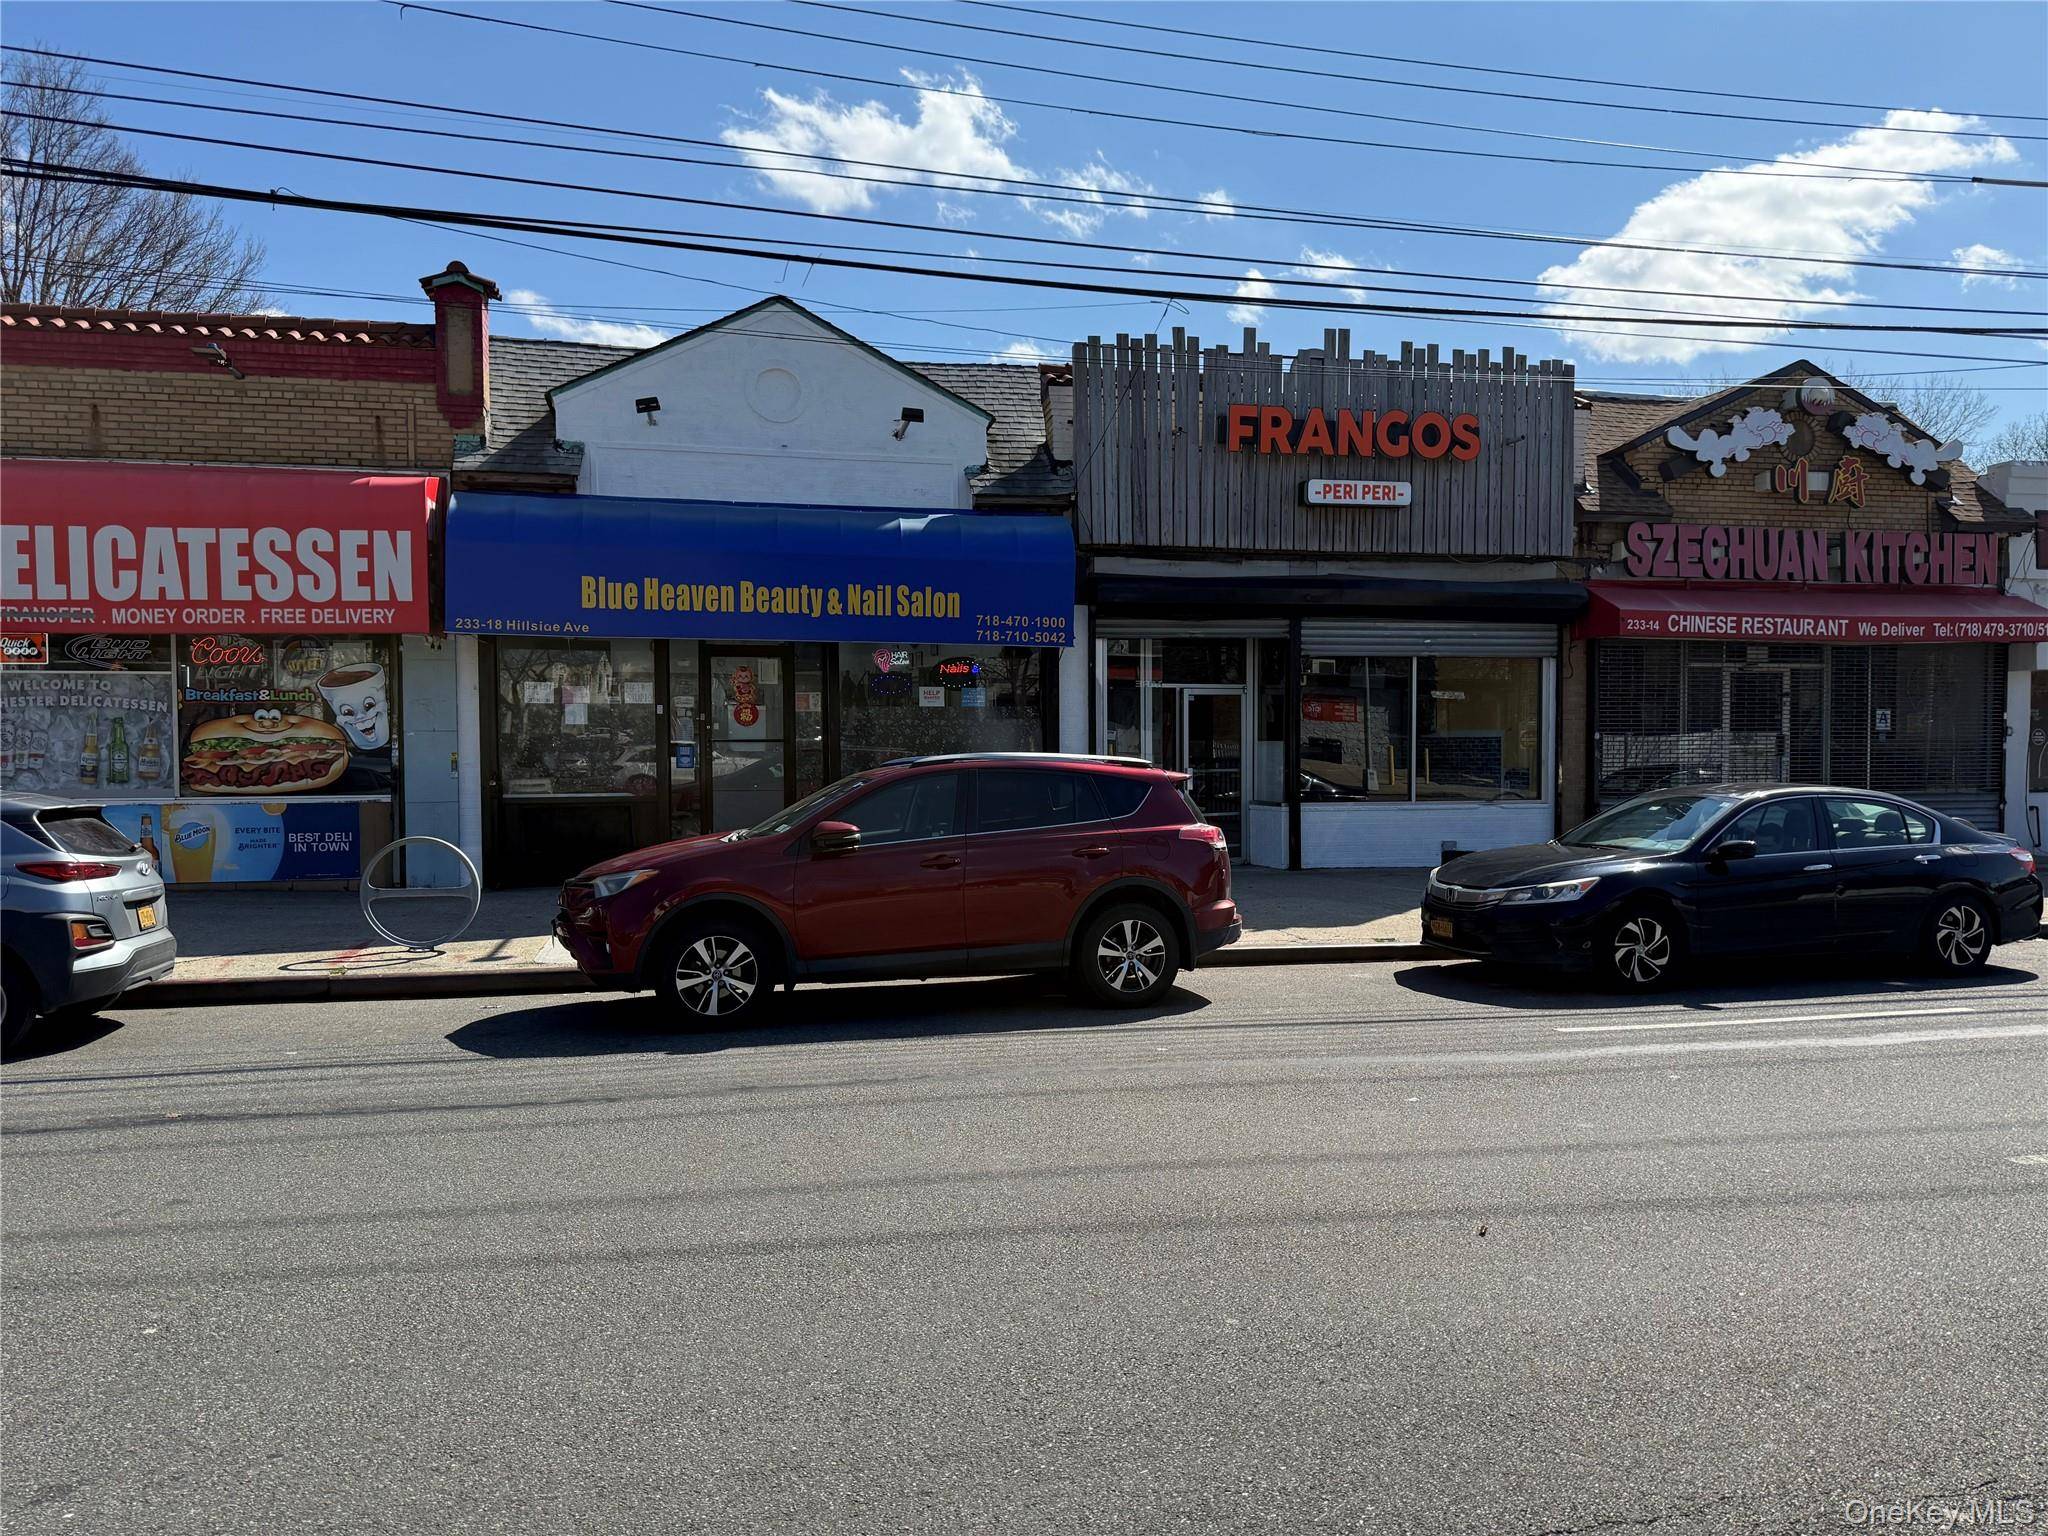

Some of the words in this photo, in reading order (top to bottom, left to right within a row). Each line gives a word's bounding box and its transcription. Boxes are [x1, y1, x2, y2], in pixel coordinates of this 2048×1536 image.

[1228, 404, 1481, 461] FRANGOS
[1626, 521, 1829, 582] SZECHUAN
[1846, 528, 1999, 585] KITCHEN
[0, 525, 413, 602] ELICATESSEN
[581, 575, 638, 610] Blue
[643, 577, 735, 612] Heaven
[740, 580, 823, 618] Beauty
[827, 587, 843, 615] &
[847, 584, 892, 616] Nail
[896, 584, 960, 618] Salon
[112, 608, 177, 624] MONEY
[182, 608, 246, 625] ORDER
[261, 608, 306, 624] FREE
[311, 608, 396, 625] DELIVERY
[976, 614, 1066, 628] 718-470-1900
[455, 617, 503, 630] 233-18
[506, 619, 560, 632] Hillside
[563, 622, 590, 633] Ave
[1627, 619, 1660, 631] 233-14
[1667, 614, 1737, 634] CHINESE
[1741, 616, 1849, 636] RESTAURANT
[1858, 622, 1878, 636] We
[1881, 622, 1926, 637] Deliver
[0, 637, 31, 649] Quick
[91, 637, 150, 649] BUD
[976, 630, 1066, 643] 718-710-5042
[76, 647, 152, 660] LIGHT
[192, 636, 265, 663] Coors
[891, 650, 909, 658] HAIR
[940, 663, 970, 674] Nails
[8, 679, 85, 691] WELCOME
[89, 680, 112, 691] TO
[60, 695, 168, 713] DELICATESSEN
[1878, 711, 1888, 724] A
[174, 832, 193, 844] BLUE
[192, 826, 211, 838] MOON
[235, 827, 261, 835] EVERY
[288, 833, 319, 844] BEST
[325, 832, 353, 842] DELI
[294, 843, 307, 853] IN
[310, 842, 350, 852] TOWN
